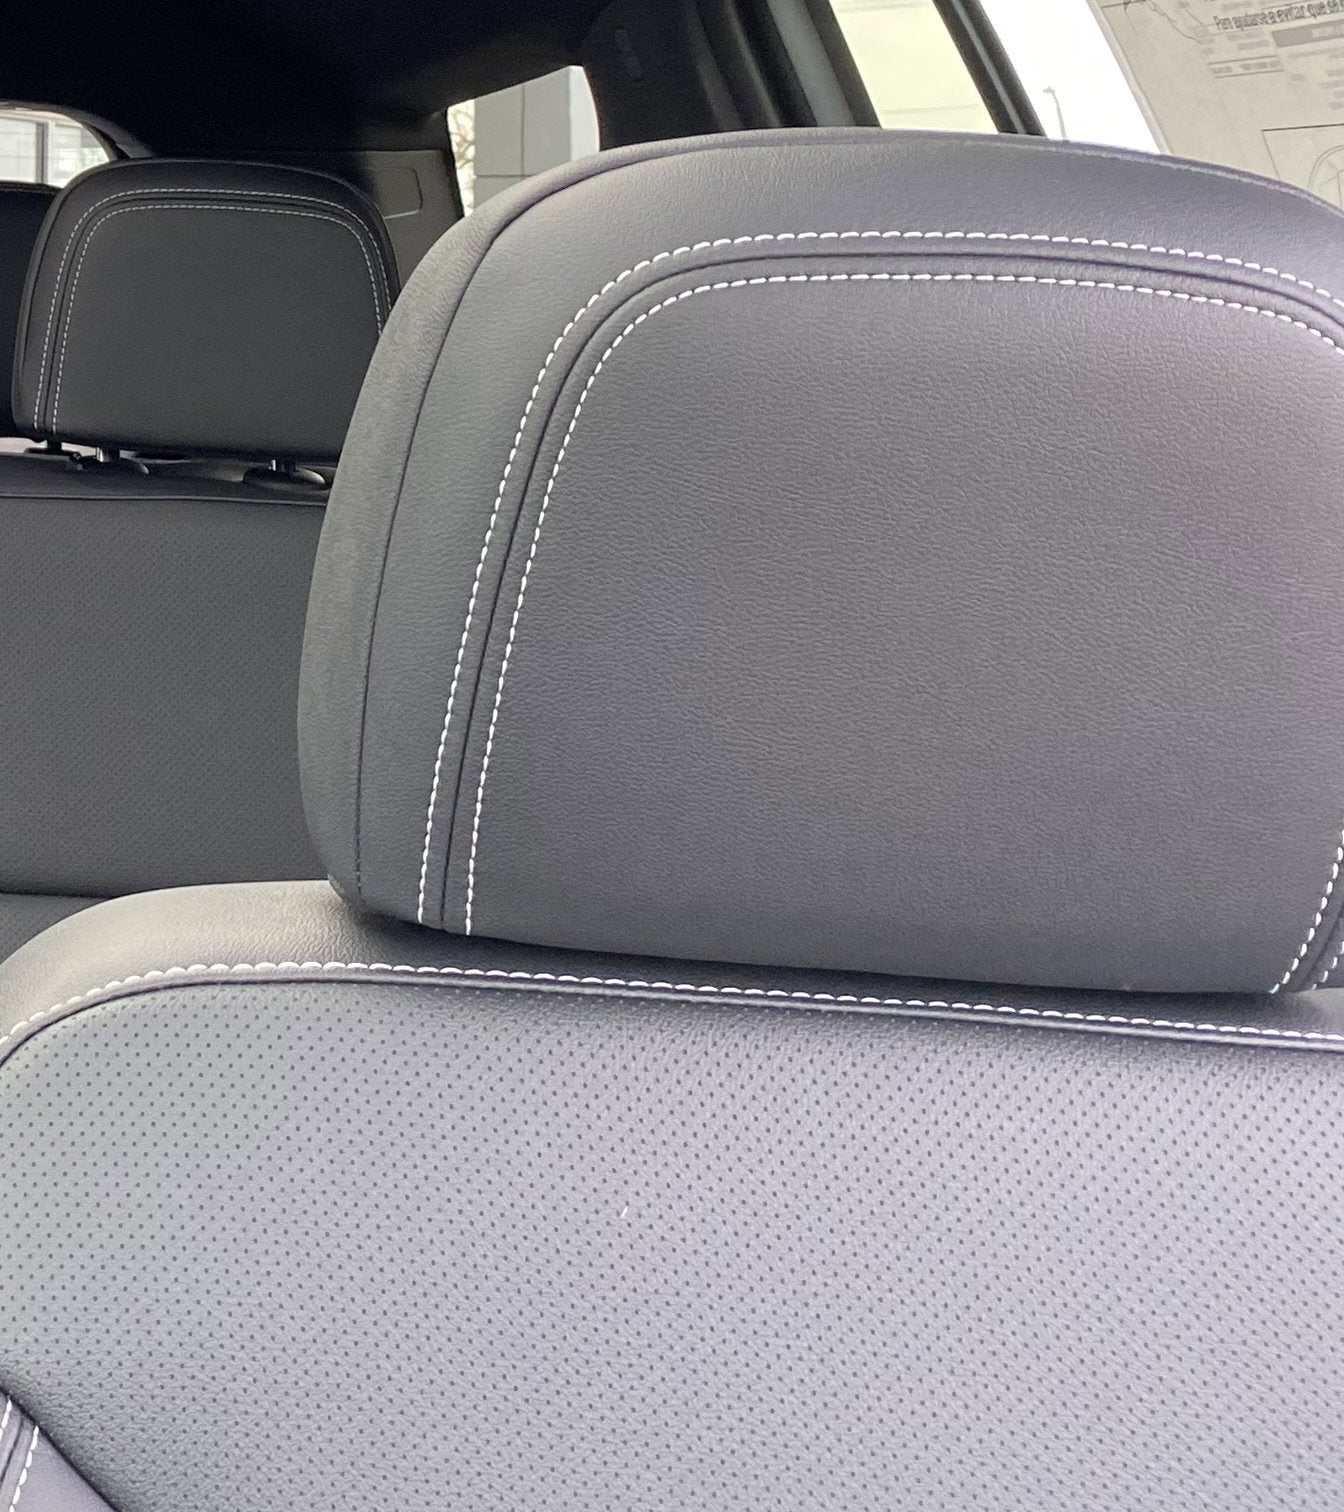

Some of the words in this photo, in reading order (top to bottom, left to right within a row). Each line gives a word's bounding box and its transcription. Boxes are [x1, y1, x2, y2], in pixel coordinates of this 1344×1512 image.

[1277, 4, 1306, 22] evitar
[1307, 1, 1325, 19] que
[1327, 0, 1339, 14] se
